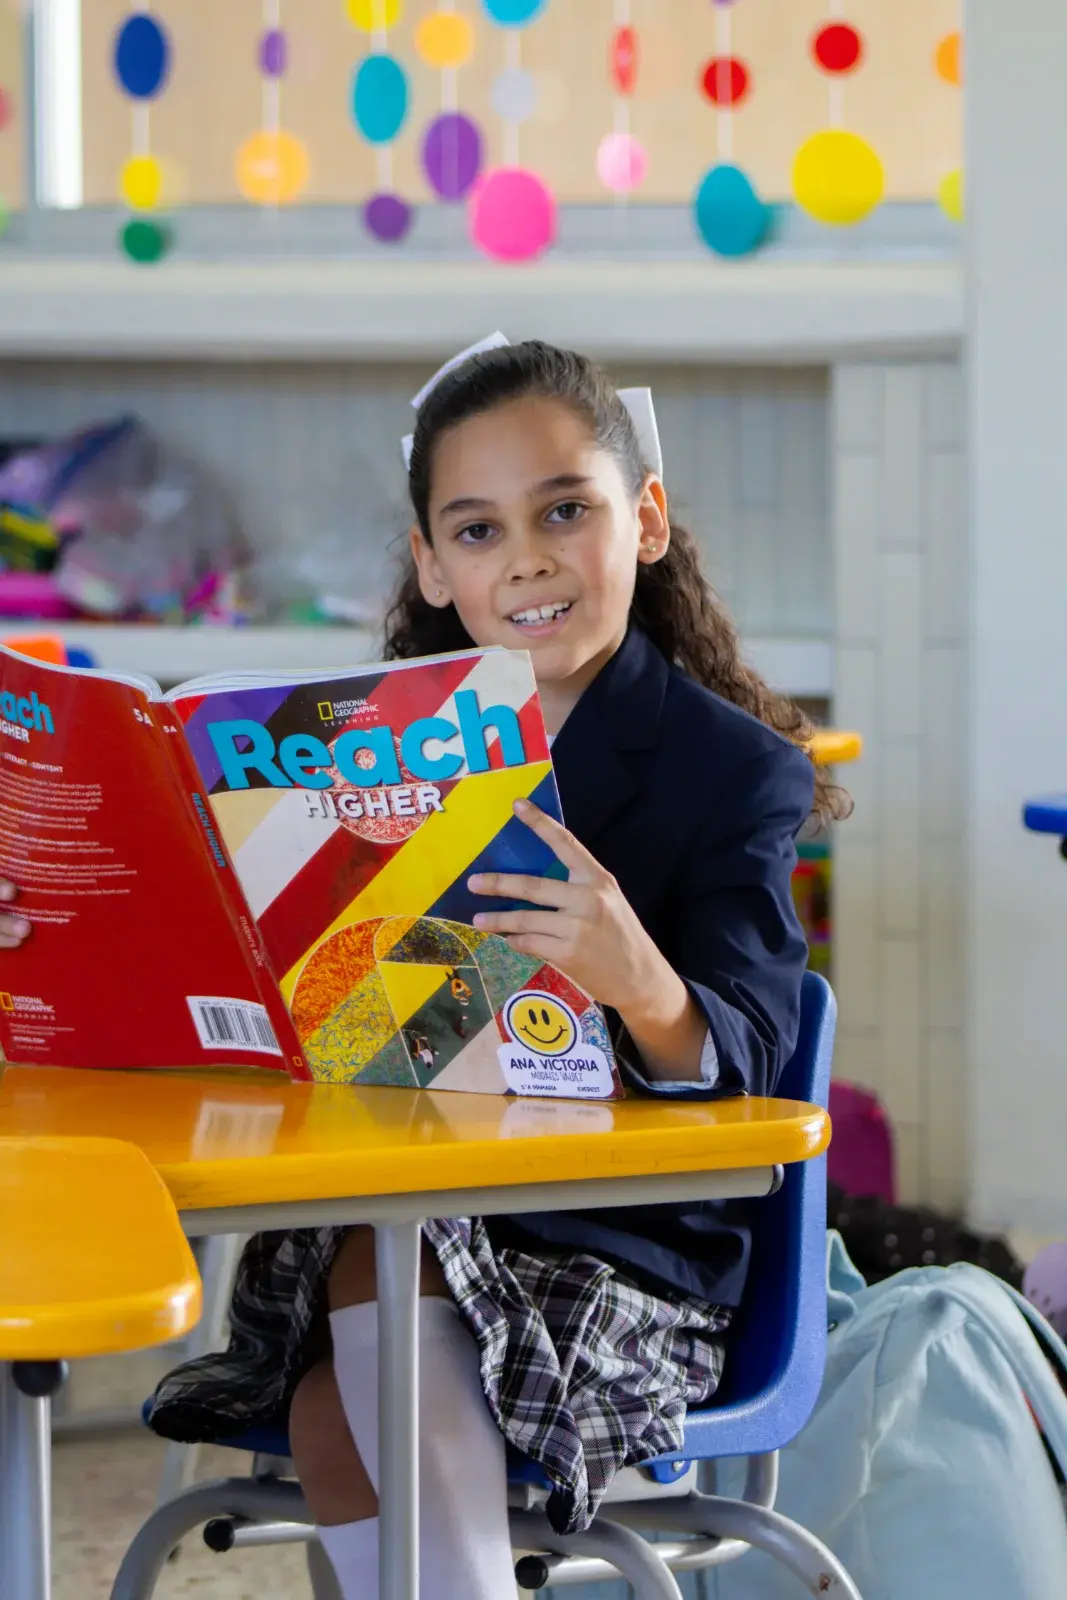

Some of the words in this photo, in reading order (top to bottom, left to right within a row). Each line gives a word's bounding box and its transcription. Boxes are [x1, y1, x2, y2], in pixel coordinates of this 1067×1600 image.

[0, 690, 56, 735] ach
[332, 698, 368, 710] NATIONAL
[334, 704, 379, 717] GEOGRAPHIC
[132, 708, 154, 727] 5A
[324, 715, 379, 727] LEARNING
[206, 689, 527, 790] Reach
[303, 785, 445, 819] HIGHER
[192, 792, 210, 827] REACH
[205, 827, 226, 868] HIGHER
[510, 1057, 537, 1070] ANA
[539, 1059, 599, 1072] VICTORIA
